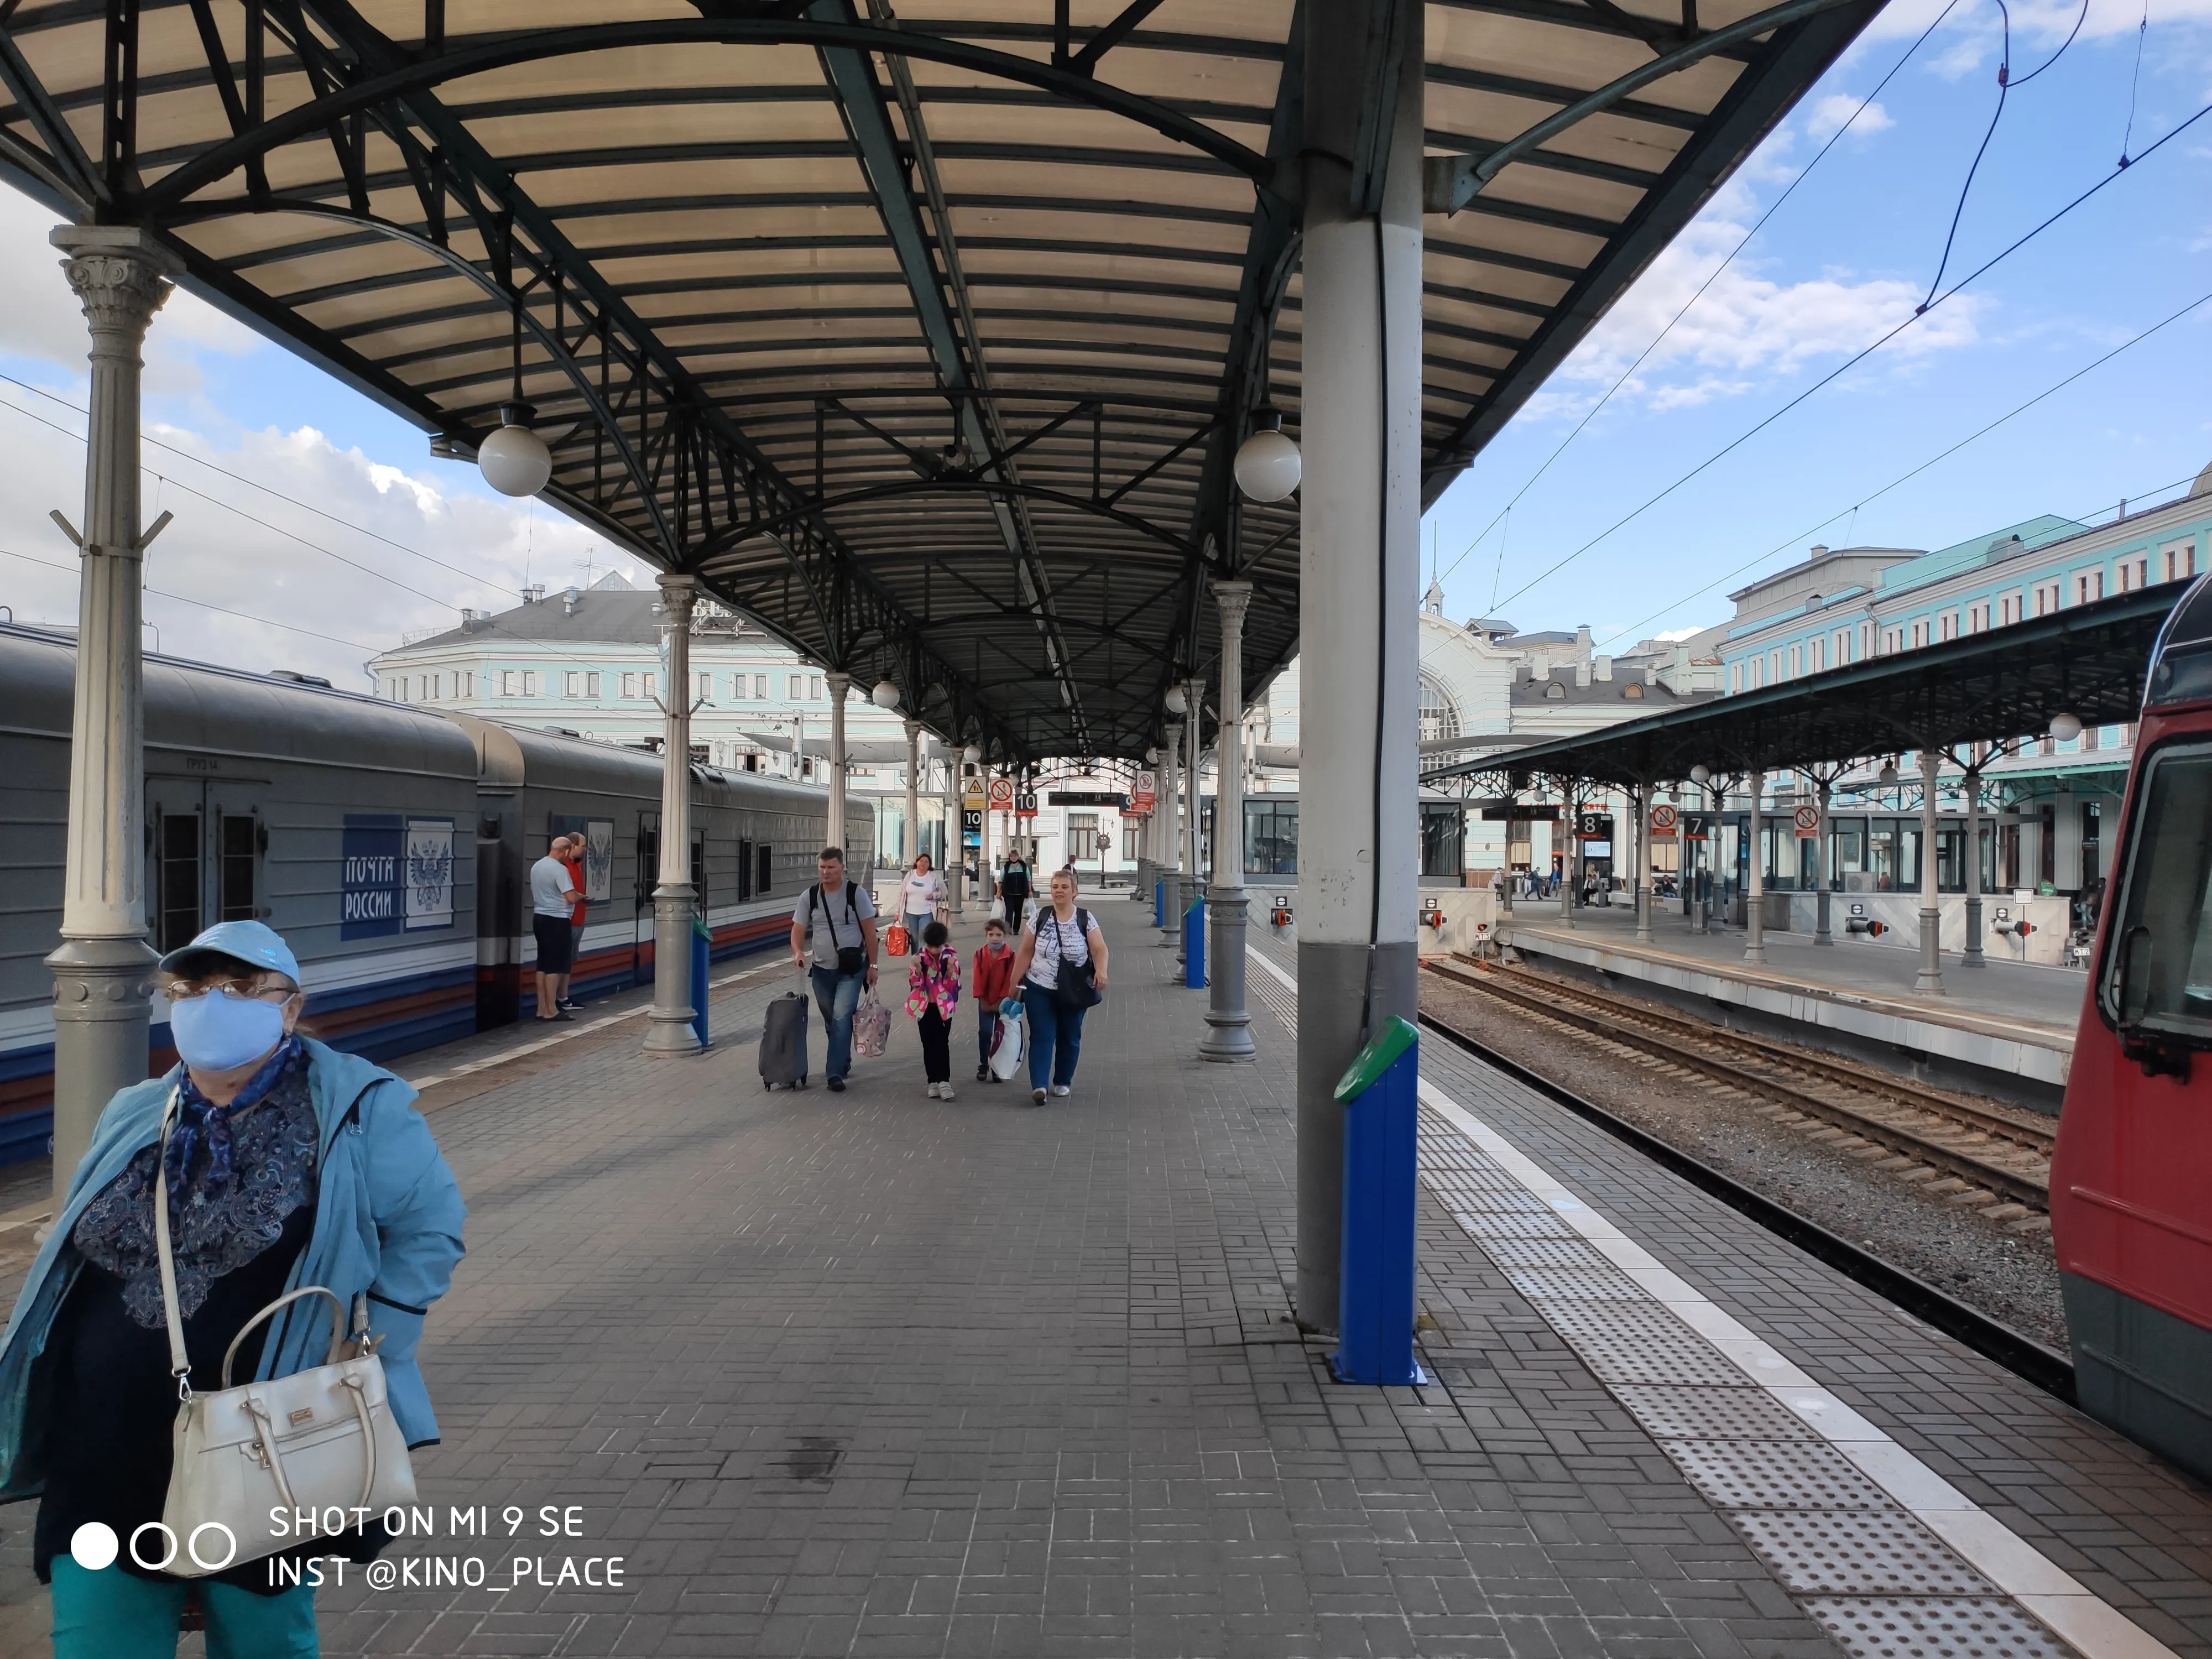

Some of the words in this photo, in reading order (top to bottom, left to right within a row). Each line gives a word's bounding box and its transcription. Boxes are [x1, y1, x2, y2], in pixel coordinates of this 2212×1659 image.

[1017, 795, 1036, 810] 10
[966, 812, 981, 825] 10
[1584, 817, 1596, 833] 8
[1691, 818, 1702, 834] 7
[346, 857, 395, 883] ПОЧТА
[346, 890, 392, 920] РОССИИ
